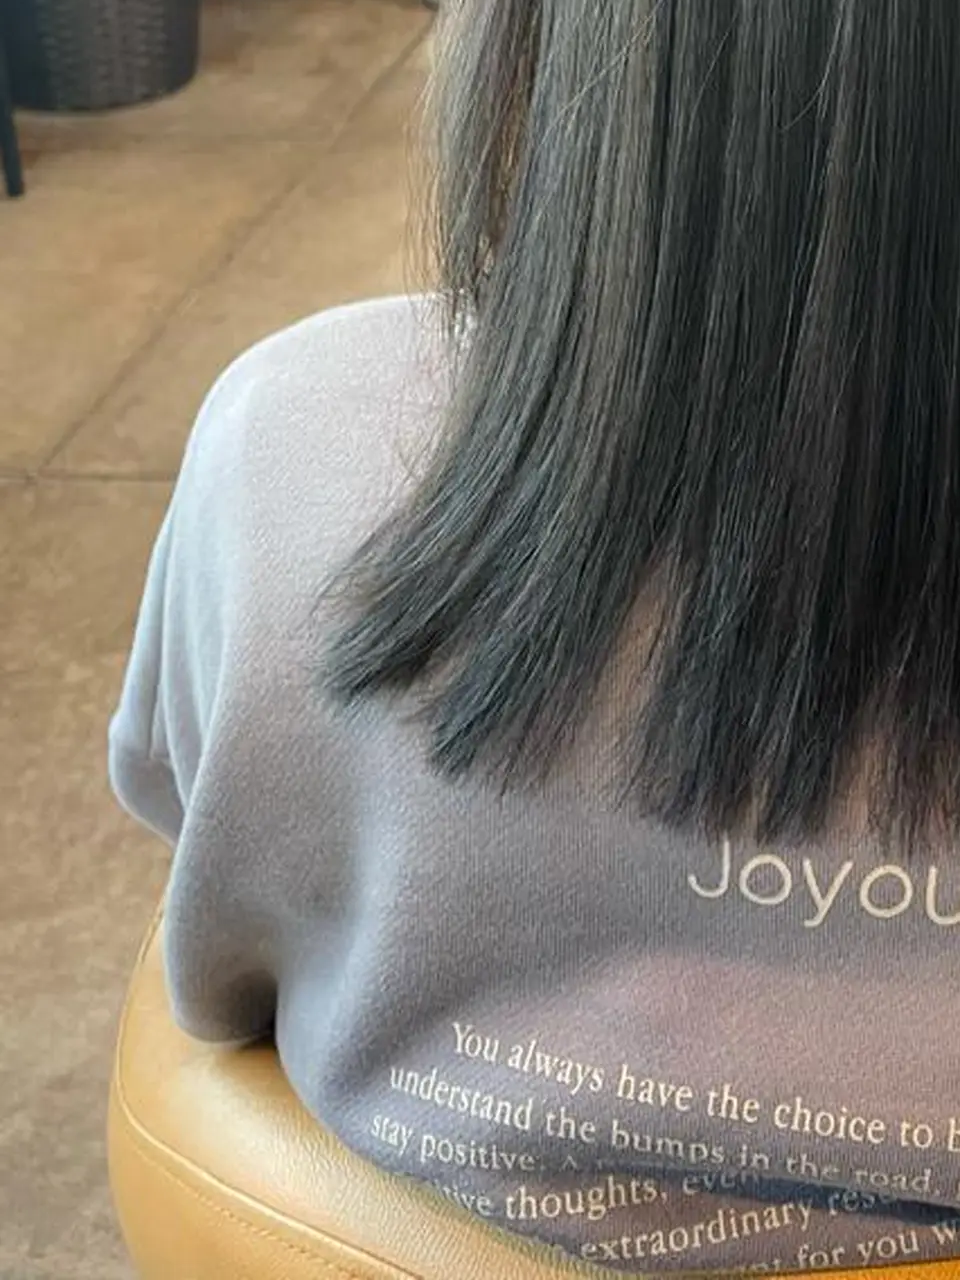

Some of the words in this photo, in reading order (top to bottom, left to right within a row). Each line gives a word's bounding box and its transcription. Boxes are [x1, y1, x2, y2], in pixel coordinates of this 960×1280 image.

[452, 1021, 499, 1062] You
[507, 1039, 605, 1095] always
[616, 1064, 694, 1112] have
[706, 1083, 761, 1124] the
[773, 1096, 887, 1144] choice
[899, 1120, 933, 1150] to
[369, 1113, 414, 1156] stay
[390, 1066, 533, 1132] understand
[545, 1106, 596, 1144] the
[610, 1119, 725, 1166] bumps
[740, 1144, 770, 1171] in
[785, 1154, 841, 1182] the
[505, 1174, 668, 1221] thoughts,
[580, 1196, 813, 1262] extraordinary
[797, 1243, 846, 1268] for
[857, 1229, 920, 1267] you
